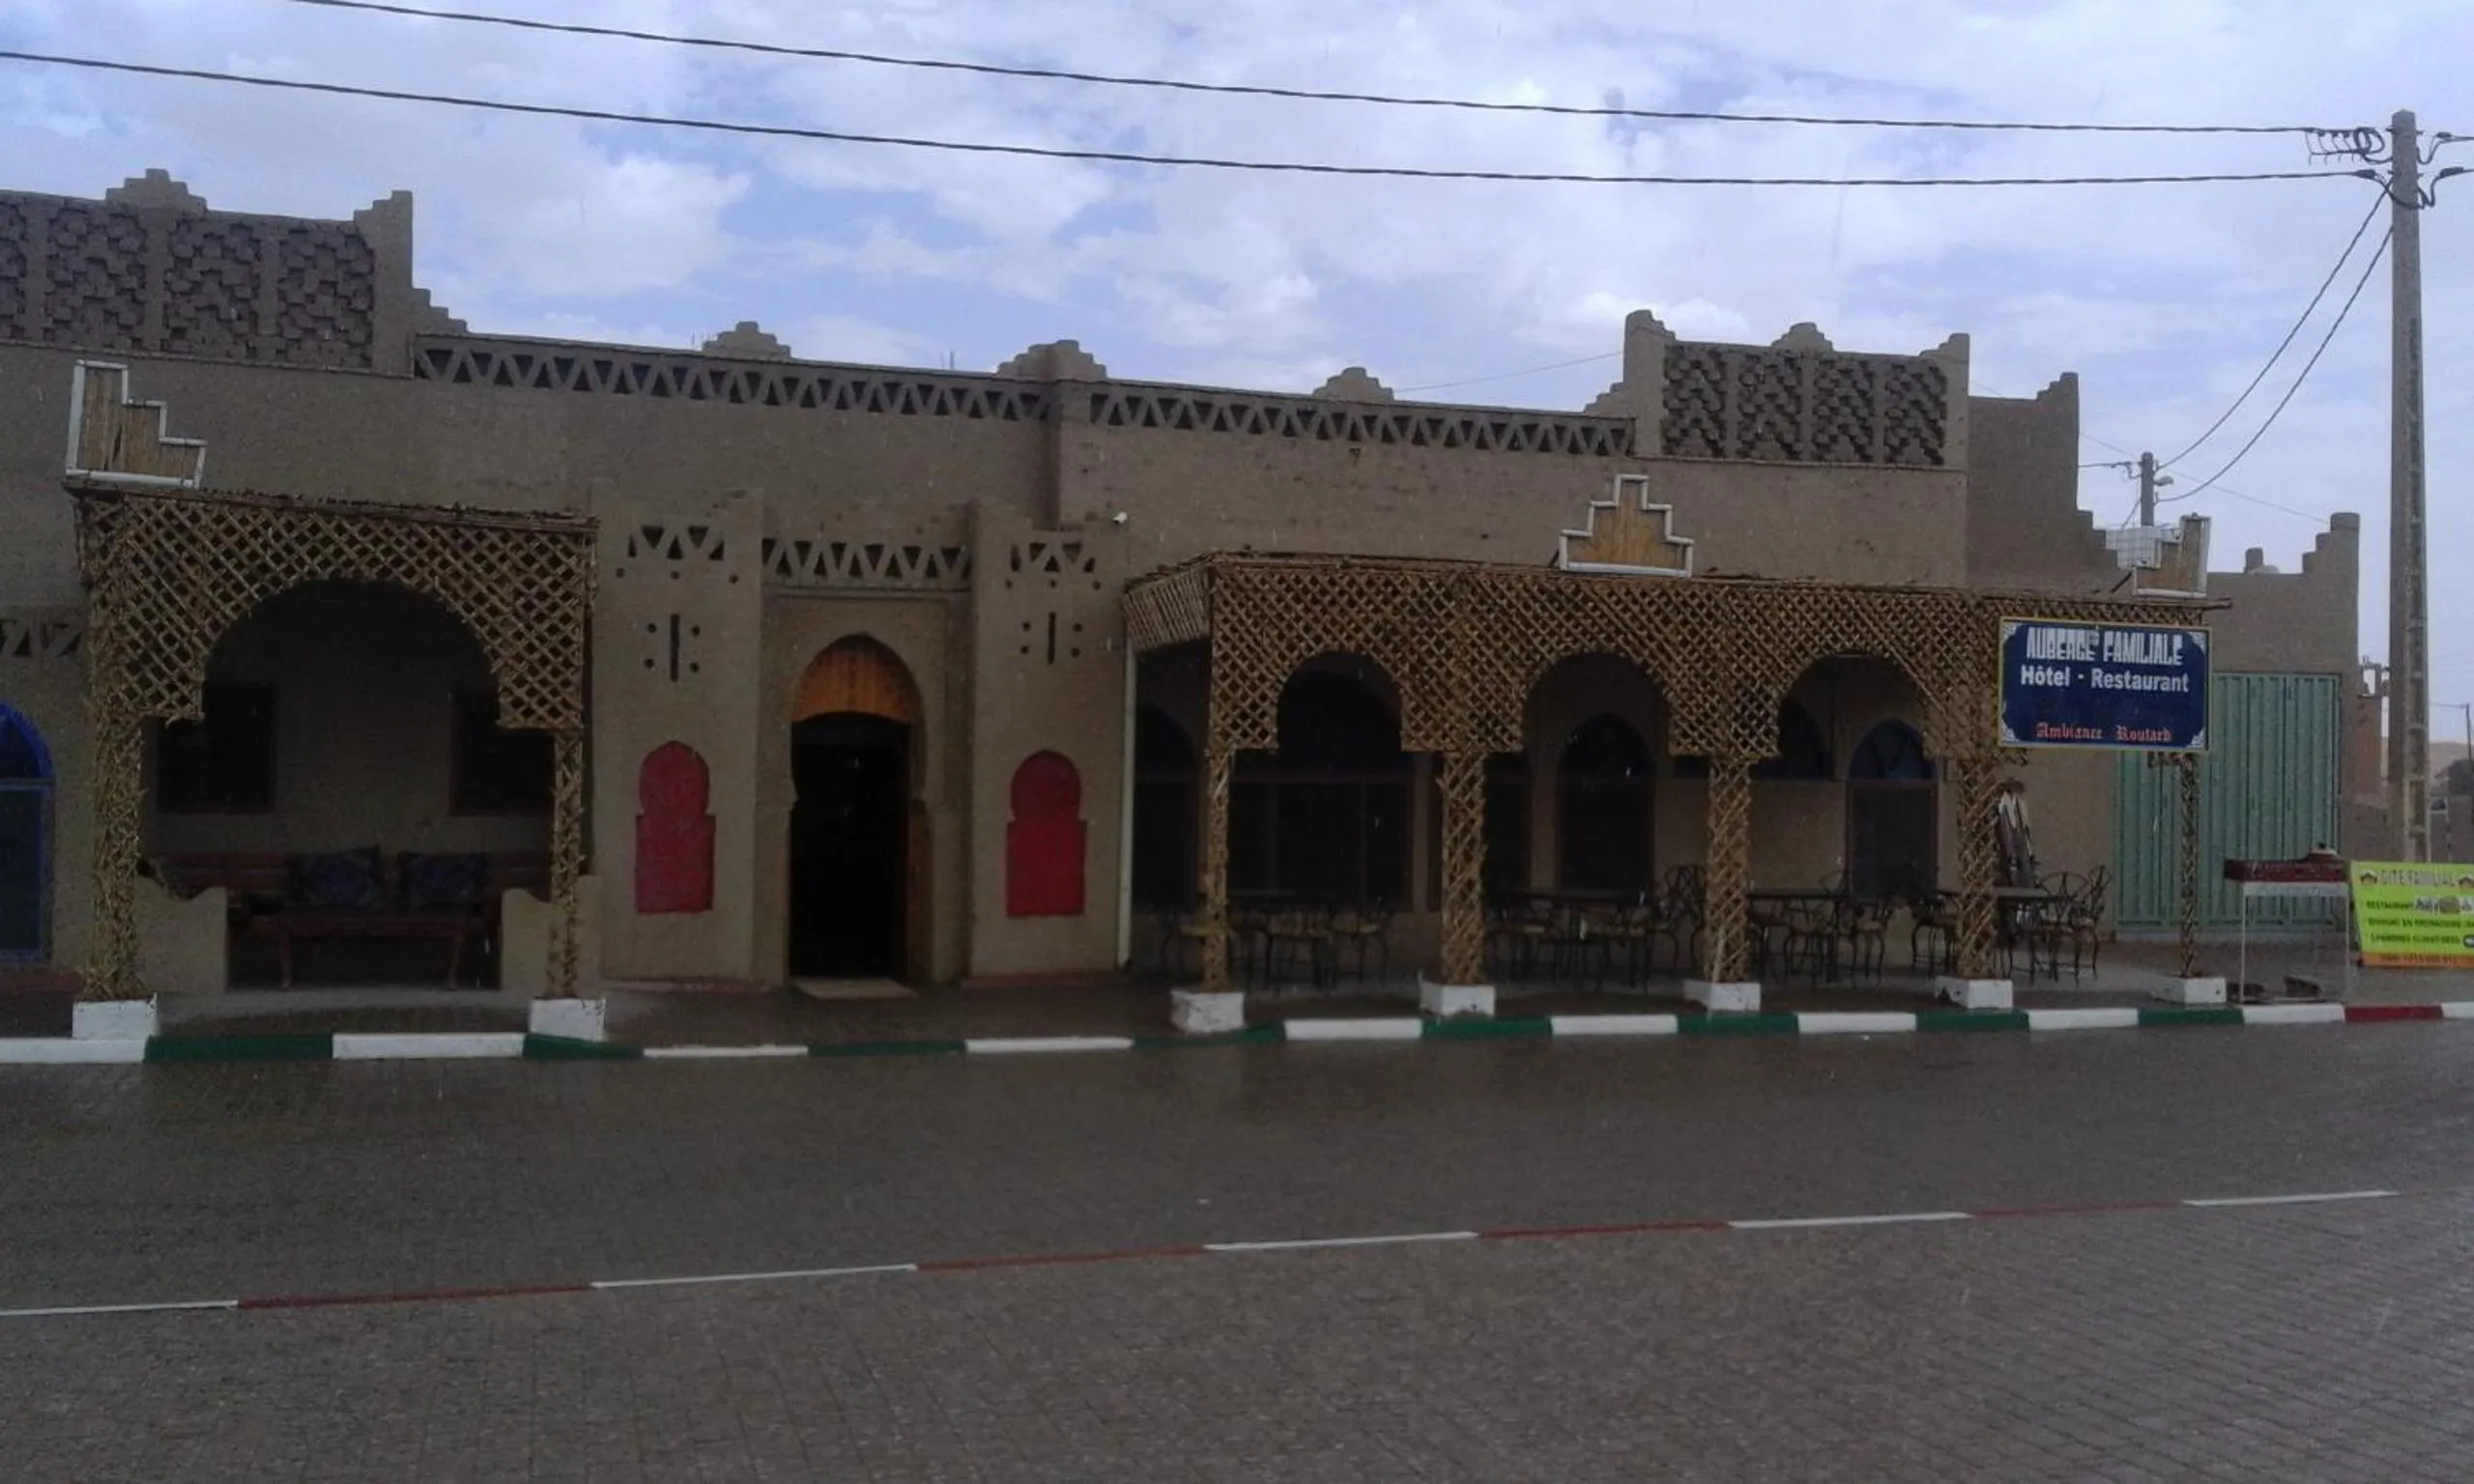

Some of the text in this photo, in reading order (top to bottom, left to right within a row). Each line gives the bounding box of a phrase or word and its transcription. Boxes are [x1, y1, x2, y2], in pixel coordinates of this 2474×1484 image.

[2026, 626, 2183, 666] AUBERGE FAMILIALE
[2020, 664, 2070, 687] Hôtel
[2090, 668, 2189, 693] Restaurant
[2035, 722, 2103, 740] Ambiance
